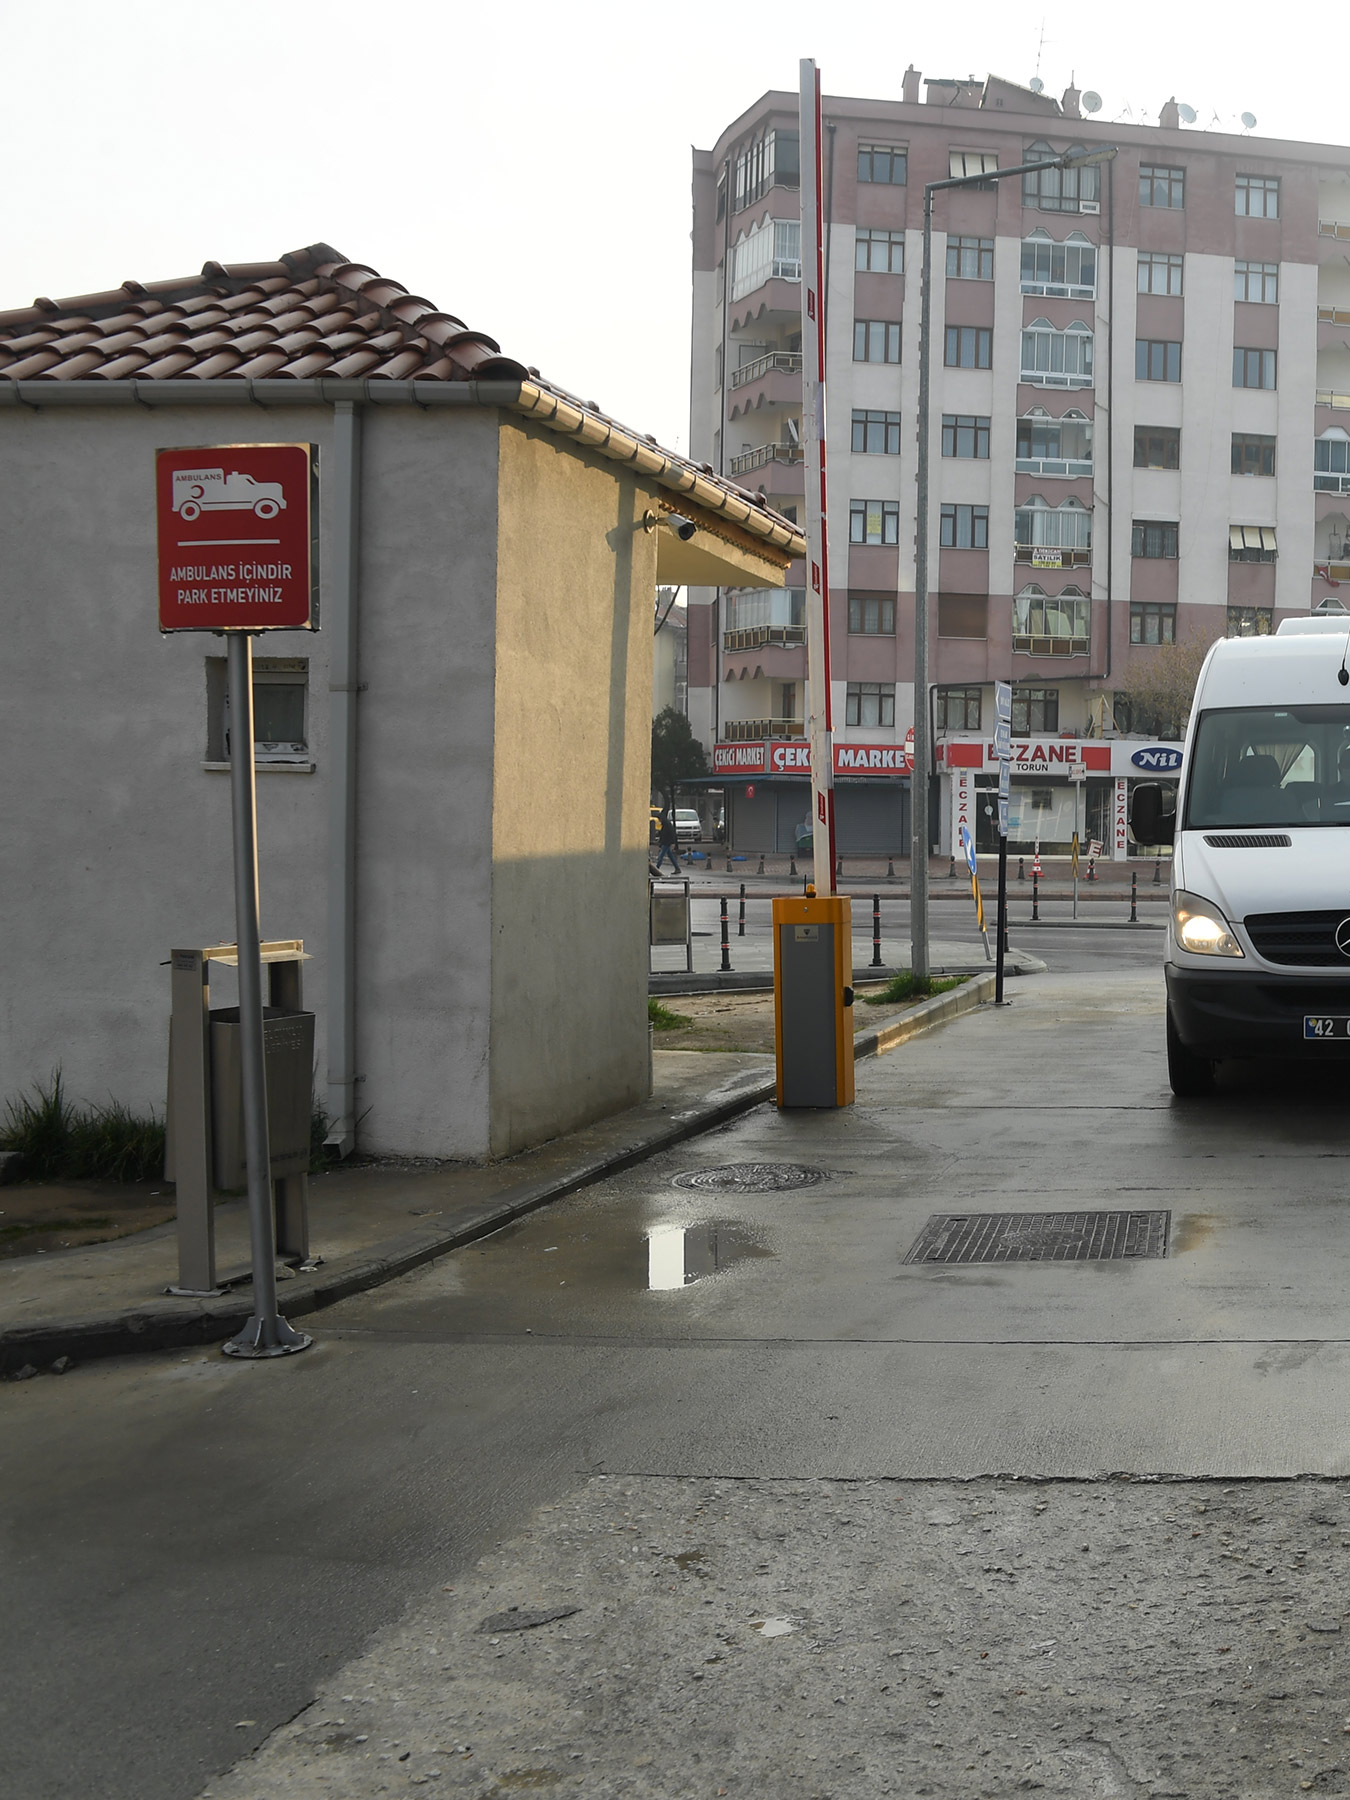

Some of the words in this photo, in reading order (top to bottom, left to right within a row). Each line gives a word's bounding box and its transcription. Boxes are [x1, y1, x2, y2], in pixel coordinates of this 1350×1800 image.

[175, 473, 222, 482] AMBULANS
[170, 564, 235, 582] AMBULANS
[239, 560, 292, 583] İÇİNDİR
[177, 588, 208, 604] PARK
[211, 584, 283, 603] ETMEYİNİZ
[715, 747, 735, 771] ÇEKİCİ
[736, 746, 764, 765] MARKET
[837, 749, 905, 768] MARKE
[1016, 763, 1049, 772] TORUN
[1138, 752, 1178, 767] Nil
[1116, 781, 1126, 849] ECZANE
[1314, 1019, 1334, 1036] 42
